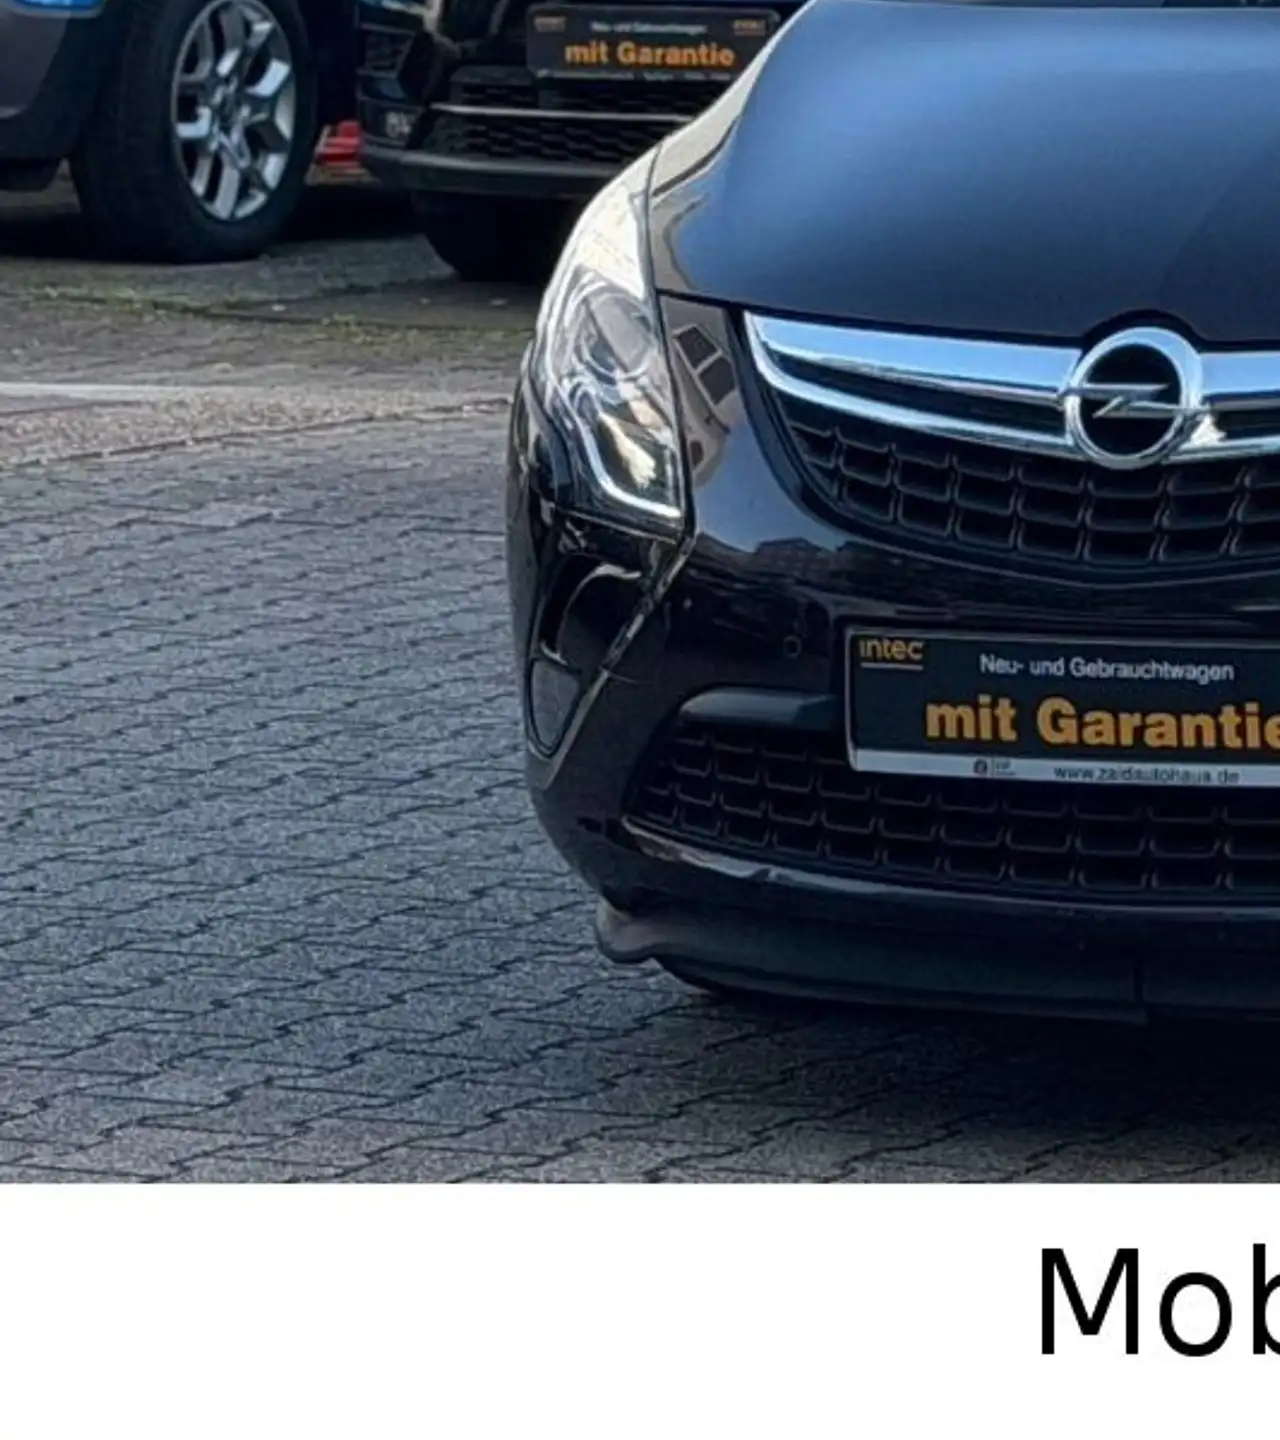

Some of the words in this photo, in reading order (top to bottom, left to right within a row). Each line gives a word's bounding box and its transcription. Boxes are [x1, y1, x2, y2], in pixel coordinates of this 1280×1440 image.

[564, 40, 609, 64] mit
[616, 42, 736, 67] Garantie
[979, 653, 1024, 674] Neu-
[1030, 658, 1065, 676] und
[1069, 655, 1235, 685] Gebrauchtwagen
[925, 693, 1017, 742] mit
